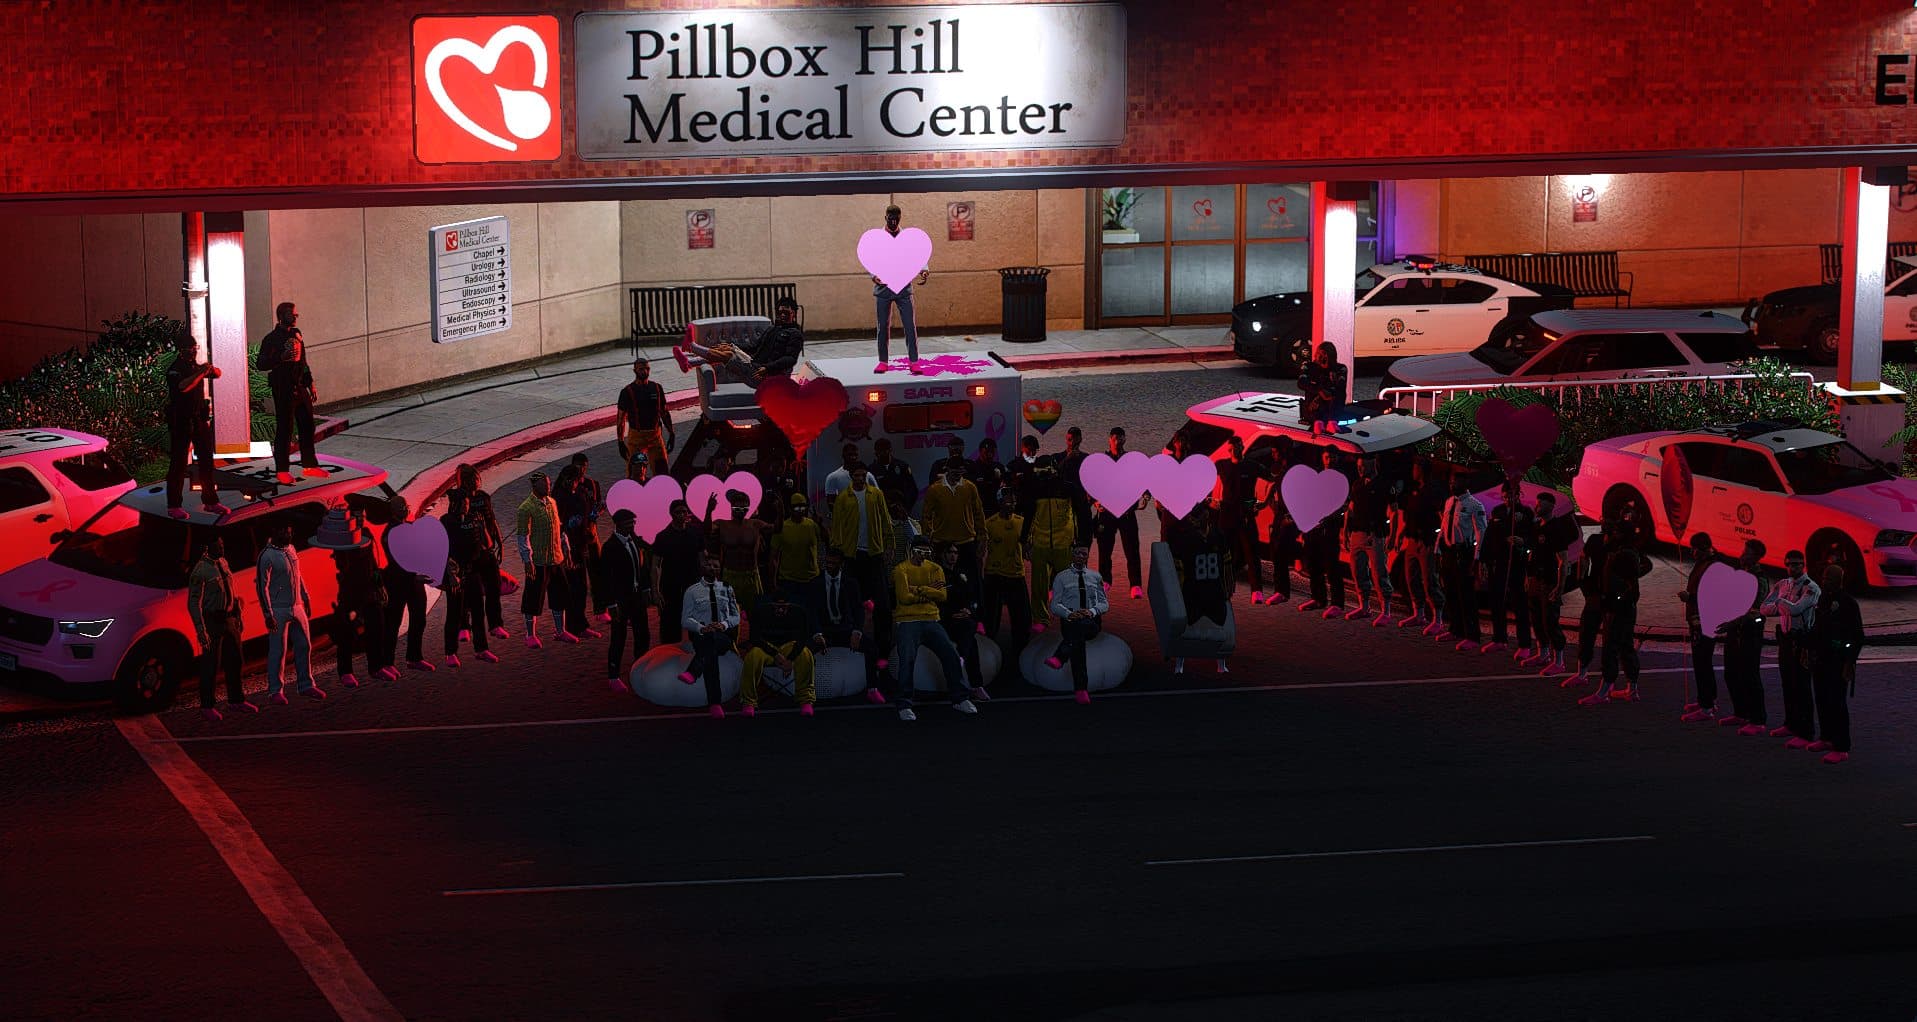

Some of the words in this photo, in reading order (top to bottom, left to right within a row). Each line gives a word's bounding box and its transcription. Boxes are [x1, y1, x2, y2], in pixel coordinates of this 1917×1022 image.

[626, 23, 828, 80] Pillbox
[855, 18, 964, 75] Hill
[623, 85, 851, 144] Medical
[880, 88, 1072, 138] Center
[460, 228, 478, 238] Pillbox
[479, 225, 490, 235] Hill
[459, 237, 480, 249] Medical
[482, 235, 500, 244] Center
[473, 248, 495, 260] Chapel
[471, 261, 496, 272] Urology
[464, 273, 496, 285] Radiology
[462, 284, 496, 298] Ultrasound
[462, 297, 496, 310] Endoscopy
[447, 312, 471, 324] Medical
[473, 308, 496, 320] Physics
[442, 324, 476, 338] Emergency
[480, 320, 497, 330] Room
[1195, 553, 1219, 580] 88
